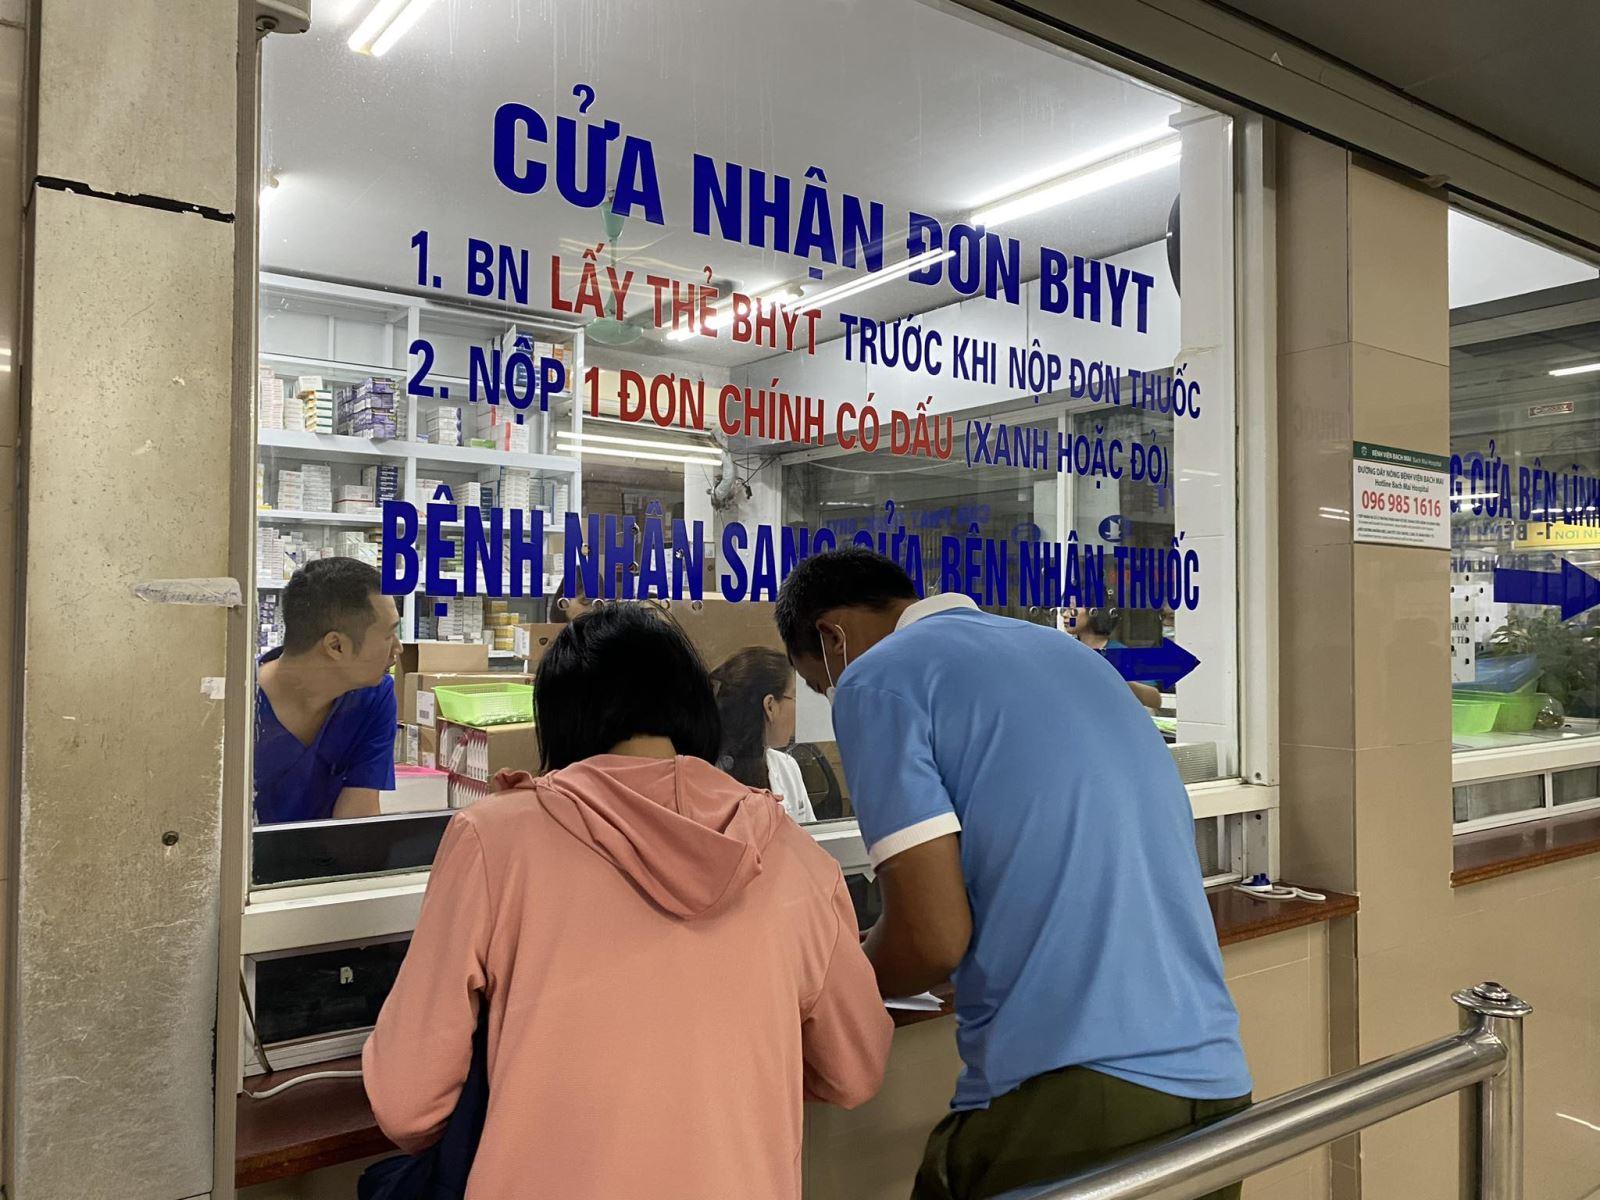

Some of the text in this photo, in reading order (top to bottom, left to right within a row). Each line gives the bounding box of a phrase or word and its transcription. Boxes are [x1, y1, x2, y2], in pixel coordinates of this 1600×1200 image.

[493, 83, 1154, 334] CỬA NHẬN ĐƠN BHYT
[411, 230, 1200, 419] 1. BN LẤY THẺ BHYT TRƯỚC KHI NỘP ĐƠN THUỐC
[408, 337, 1168, 488] 2. NỘP 1 ĐƠN CHÍNH CÓ DẤU (XANH HOẶC ĐỎ)
[381, 484, 544, 616] BỆNH
[563, 501, 704, 600] NHÂN
[941, 522, 1007, 607] BÊN
[1019, 530, 1103, 627] NHẬN
[1113, 531, 1200, 611] THUỐC
[1362, 490, 1441, 517] 096 985 1616
[1374, 479, 1391, 488] Hotline
[1412, 484, 1429, 493] Hospital
[1519, 457, 1556, 523] BÊN
